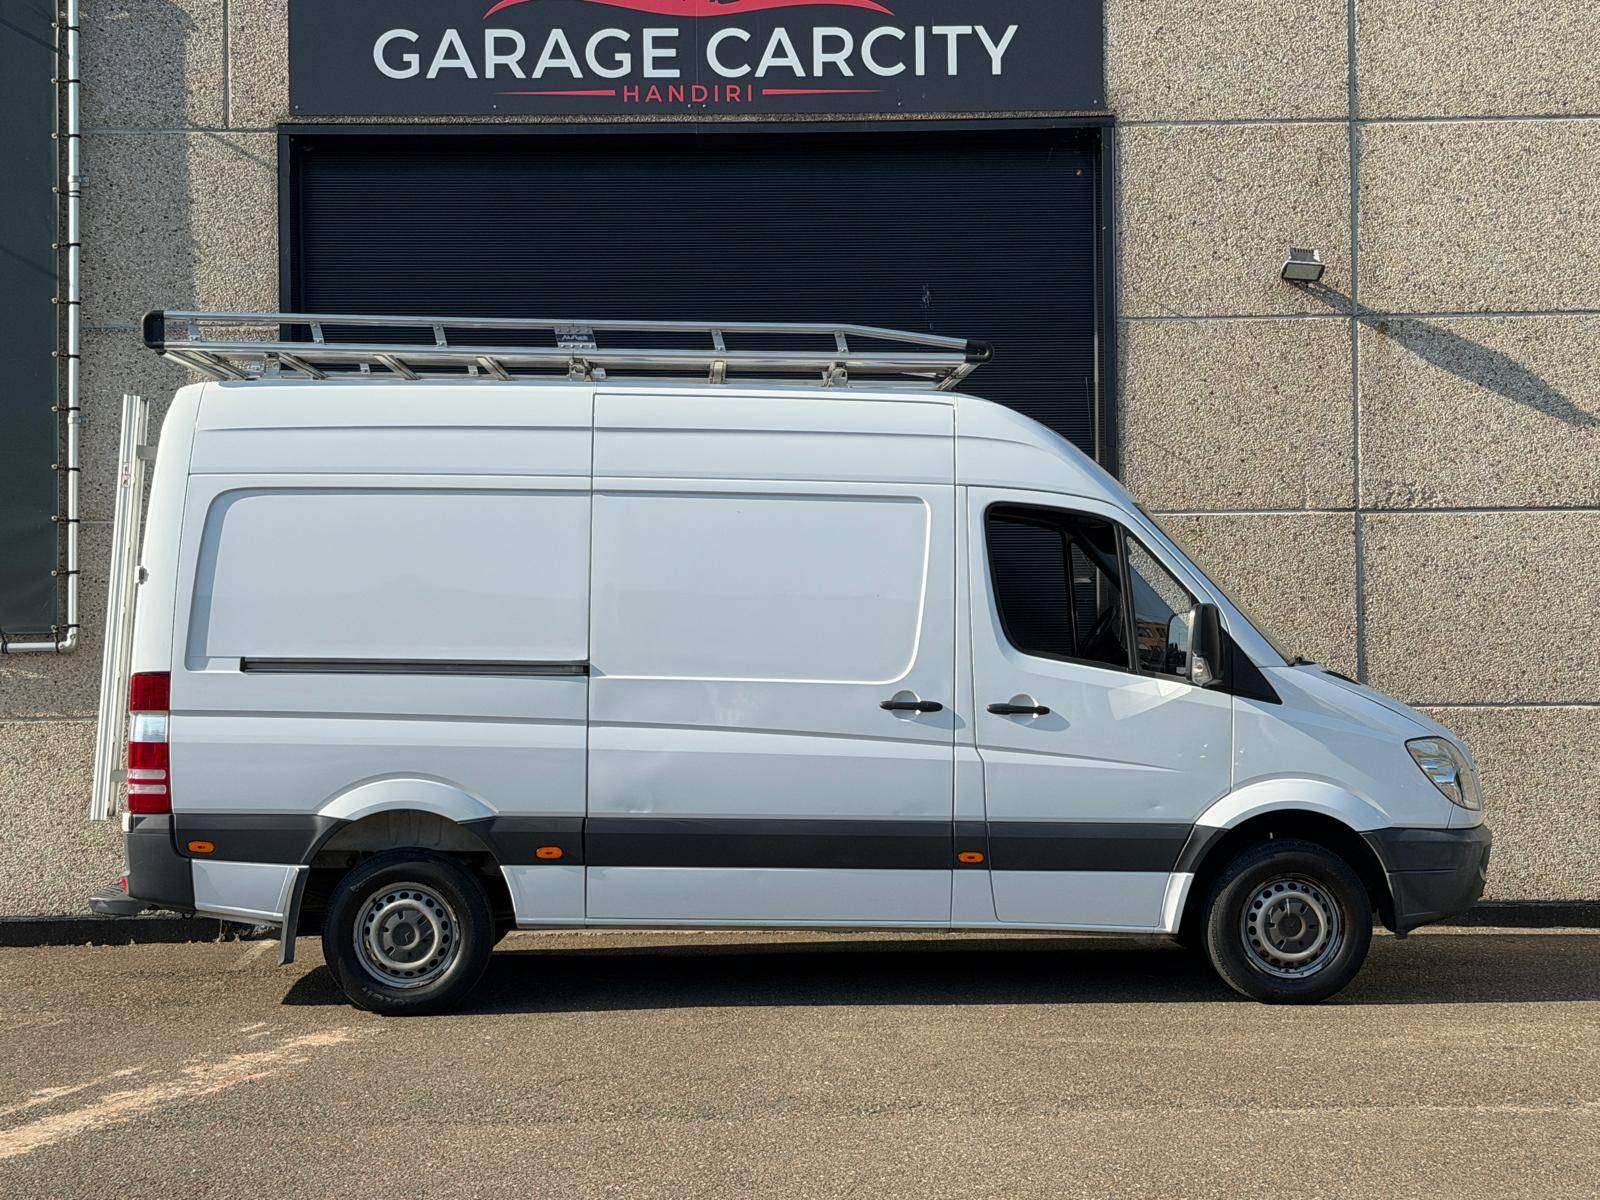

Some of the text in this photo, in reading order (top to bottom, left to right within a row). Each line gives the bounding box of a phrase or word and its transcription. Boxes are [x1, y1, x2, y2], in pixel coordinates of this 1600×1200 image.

[373, 24, 1019, 80] GARAGE CARCITY
[622, 84, 753, 103] HANDIRI
